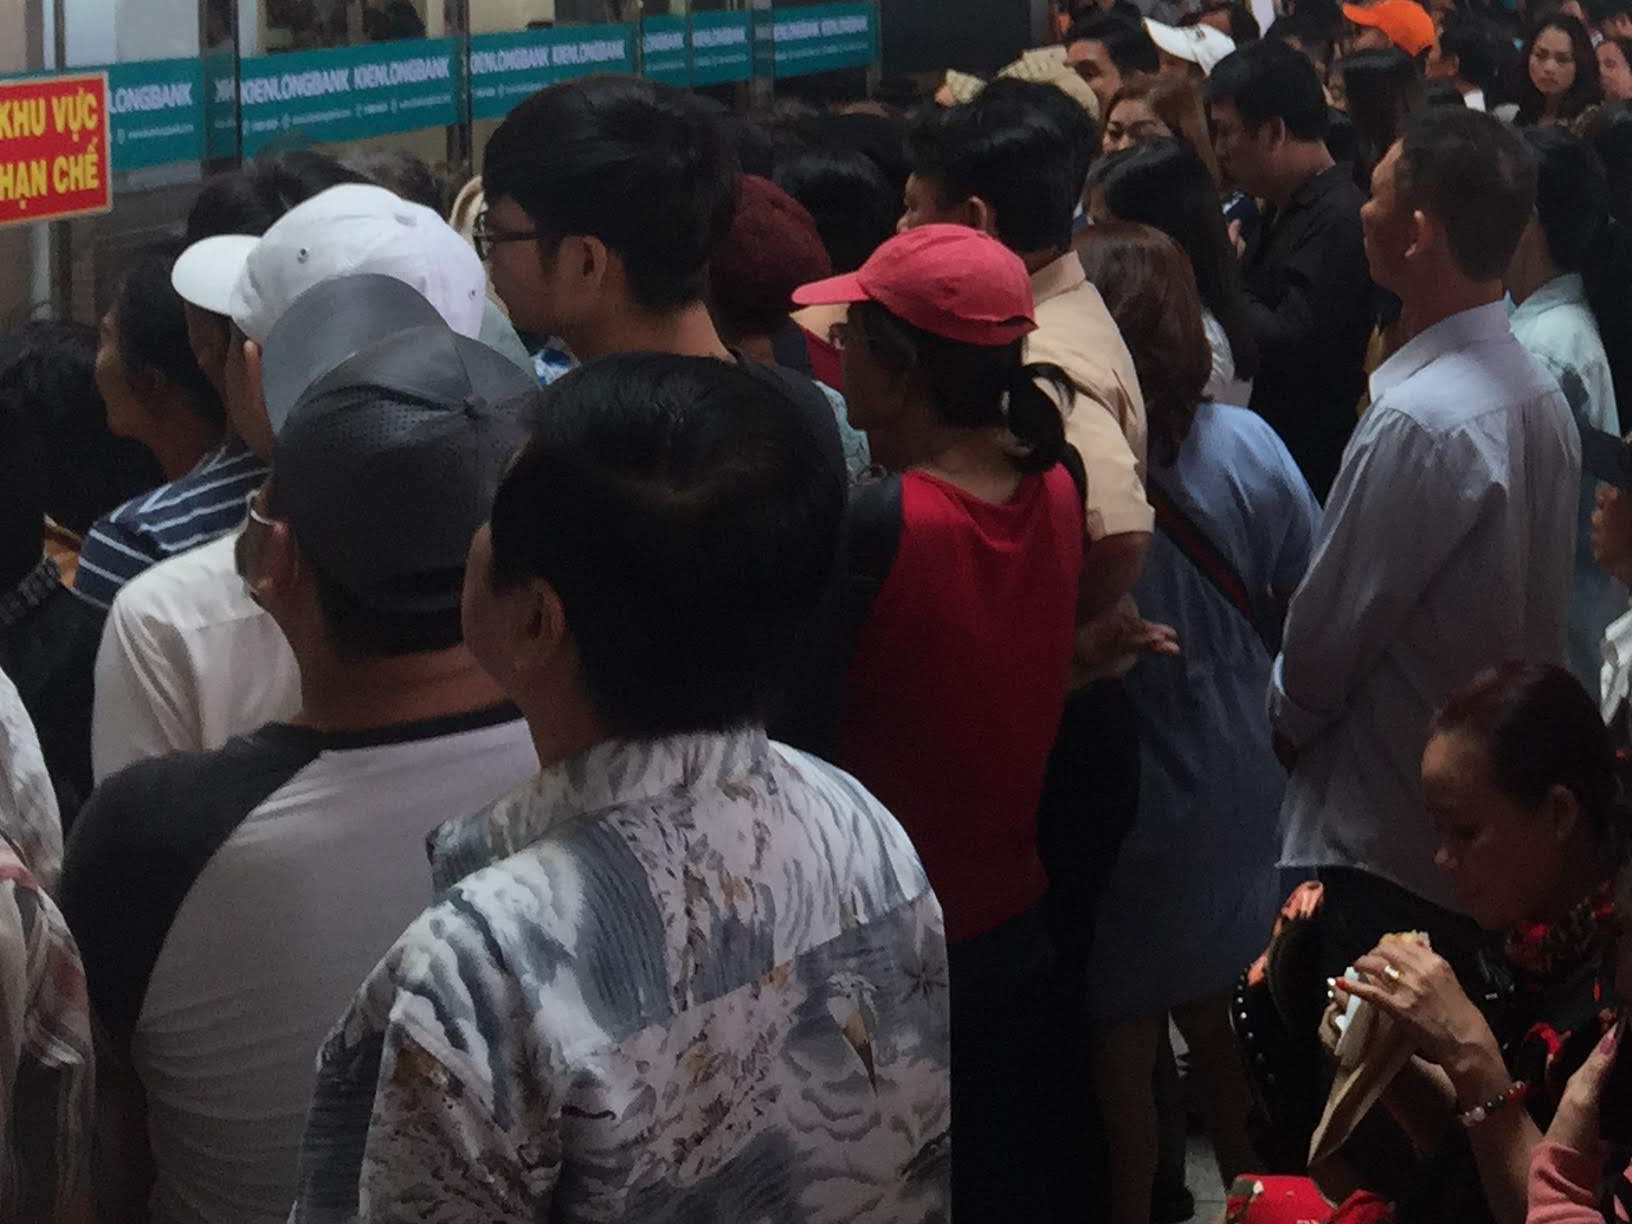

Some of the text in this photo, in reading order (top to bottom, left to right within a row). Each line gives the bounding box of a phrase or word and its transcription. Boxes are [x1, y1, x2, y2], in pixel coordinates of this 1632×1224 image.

[0, 87, 99, 143] KHU VỰC
[0, 137, 100, 210] HẠN CHẾ
